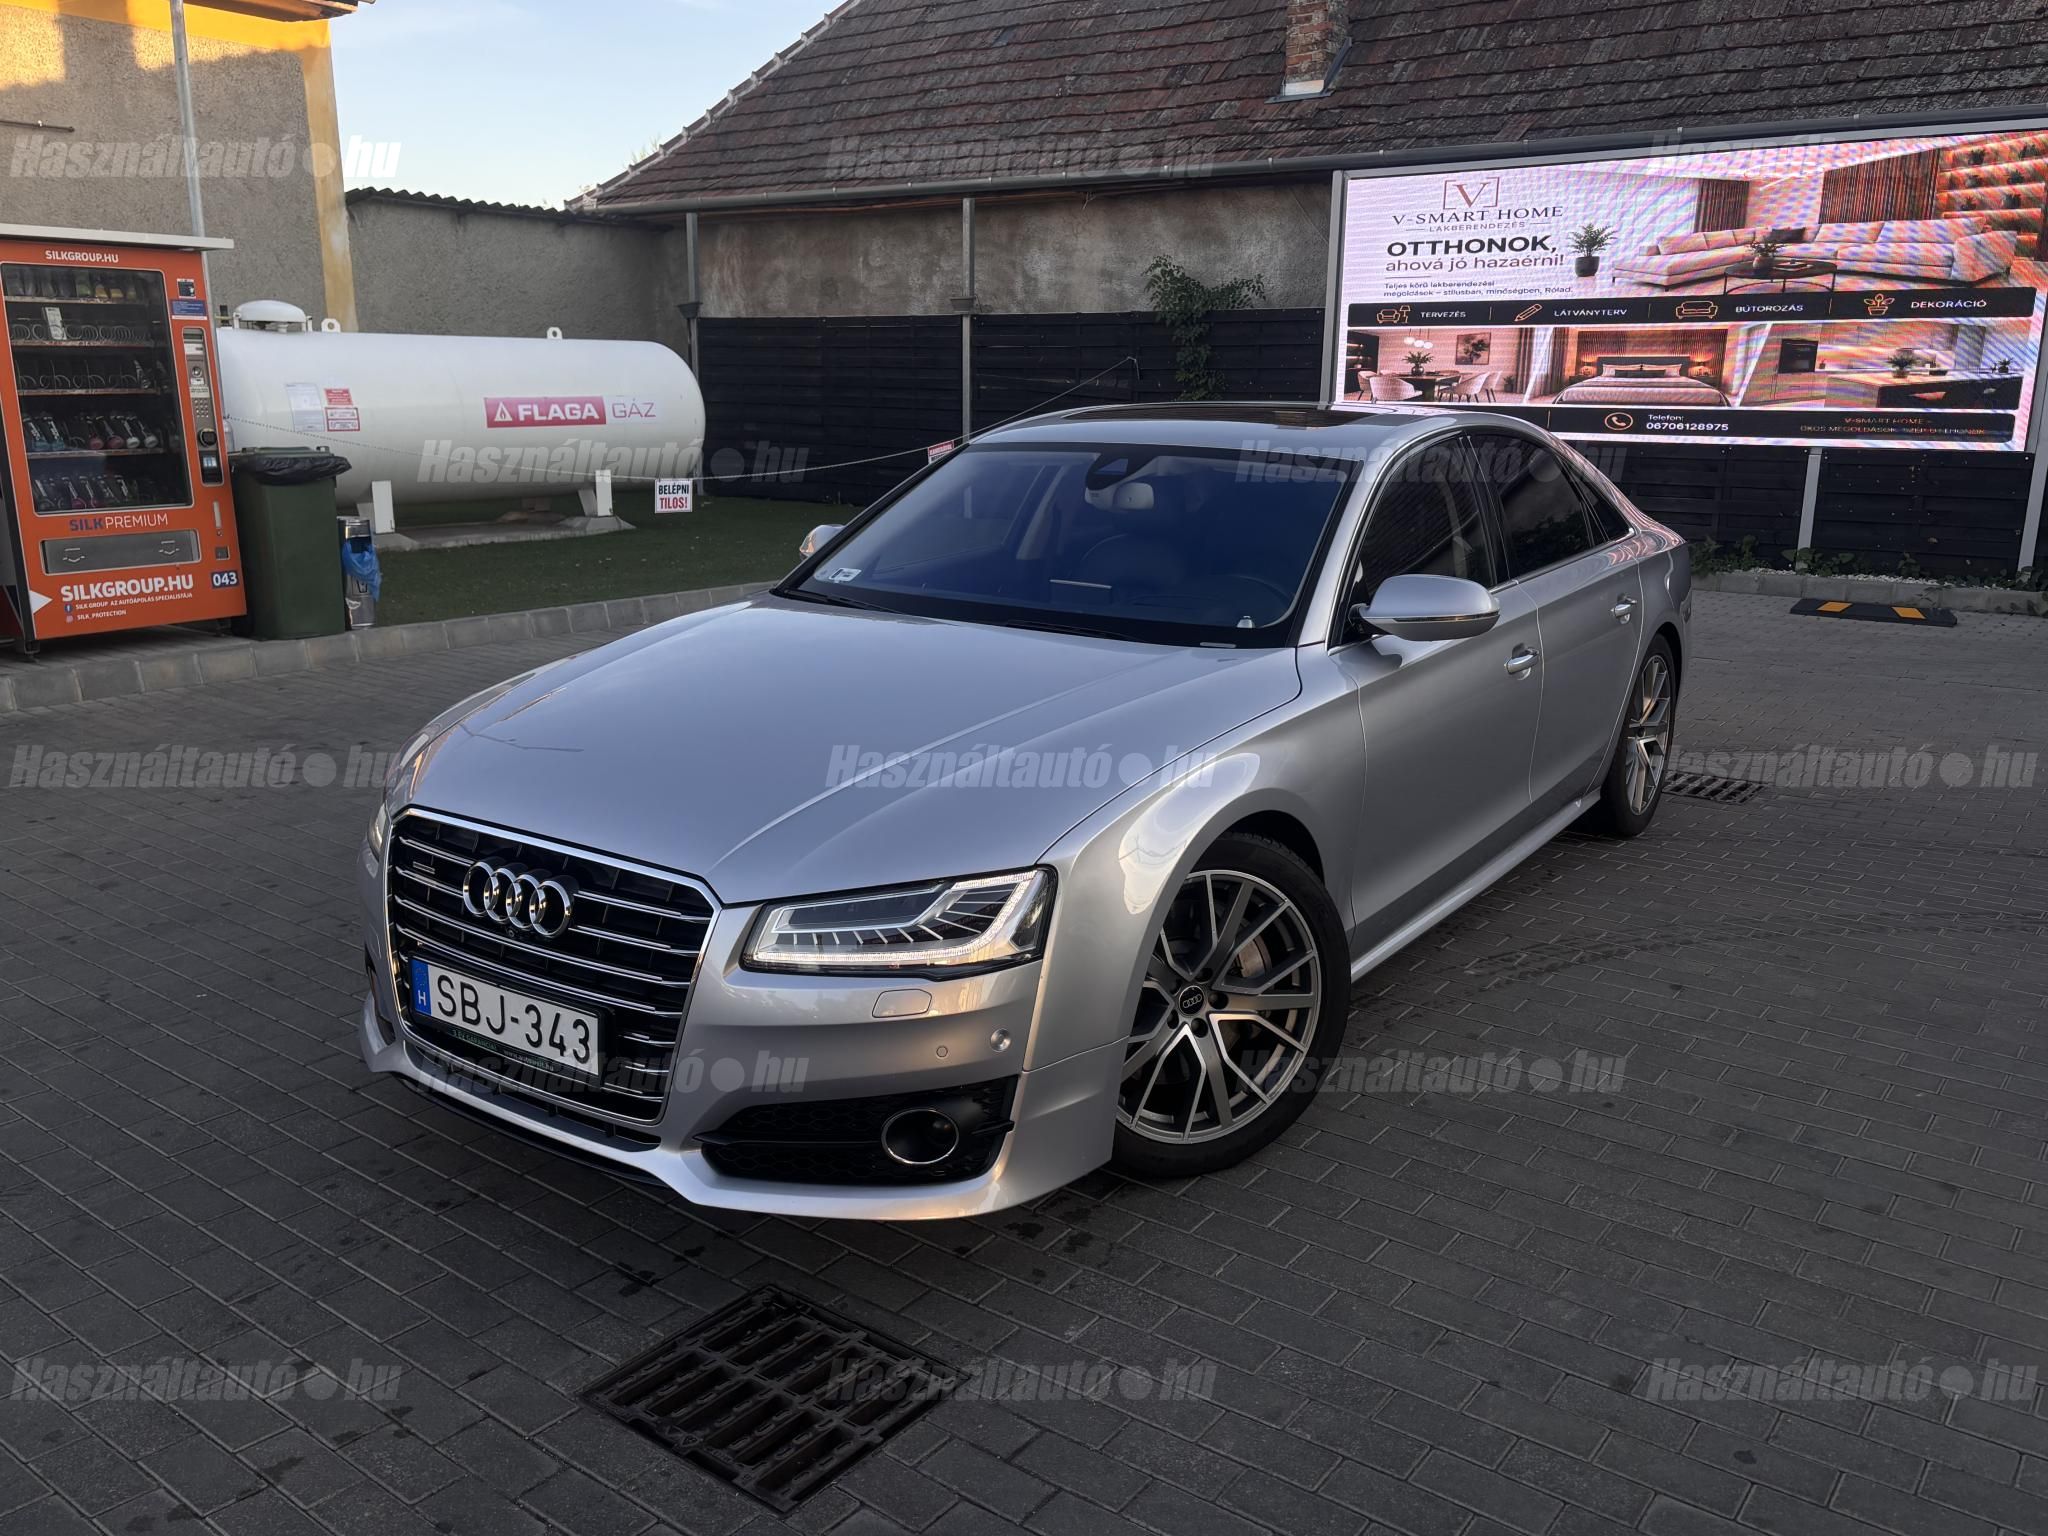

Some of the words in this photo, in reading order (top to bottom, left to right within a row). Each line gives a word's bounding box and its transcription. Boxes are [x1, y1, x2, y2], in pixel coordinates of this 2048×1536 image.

[1392, 210, 1490, 225] V-SMART
[1498, 206, 1563, 220] HOME
[1429, 221, 1526, 232] LAKBERENDEZÉS
[1387, 235, 1557, 257] OTTHONOK,
[45, 250, 119, 263] SILKGROUP.HU
[1385, 258, 1443, 272] ahová
[1448, 258, 1467, 273] jó
[1474, 254, 1565, 269] hazaérni!
[1735, 303, 1804, 313] BÚTOROZÁS
[1910, 299, 1988, 310] DEKORÁCIÓ
[1420, 310, 1467, 319] TERVEZÉS
[1554, 308, 1628, 318] LÁTVÁNYTERV
[518, 403, 600, 421] FLAGA
[612, 399, 656, 418] GÁZ
[1645, 422, 1729, 431] 06706128975
[658, 483, 690, 495] BELÉPNI
[659, 496, 688, 509] TILOS!
[212, 572, 238, 586] 043
[61, 574, 193, 602] SILKGROUP.HU
[417, 990, 427, 1007] H
[437, 974, 590, 1065] SBJ-343
